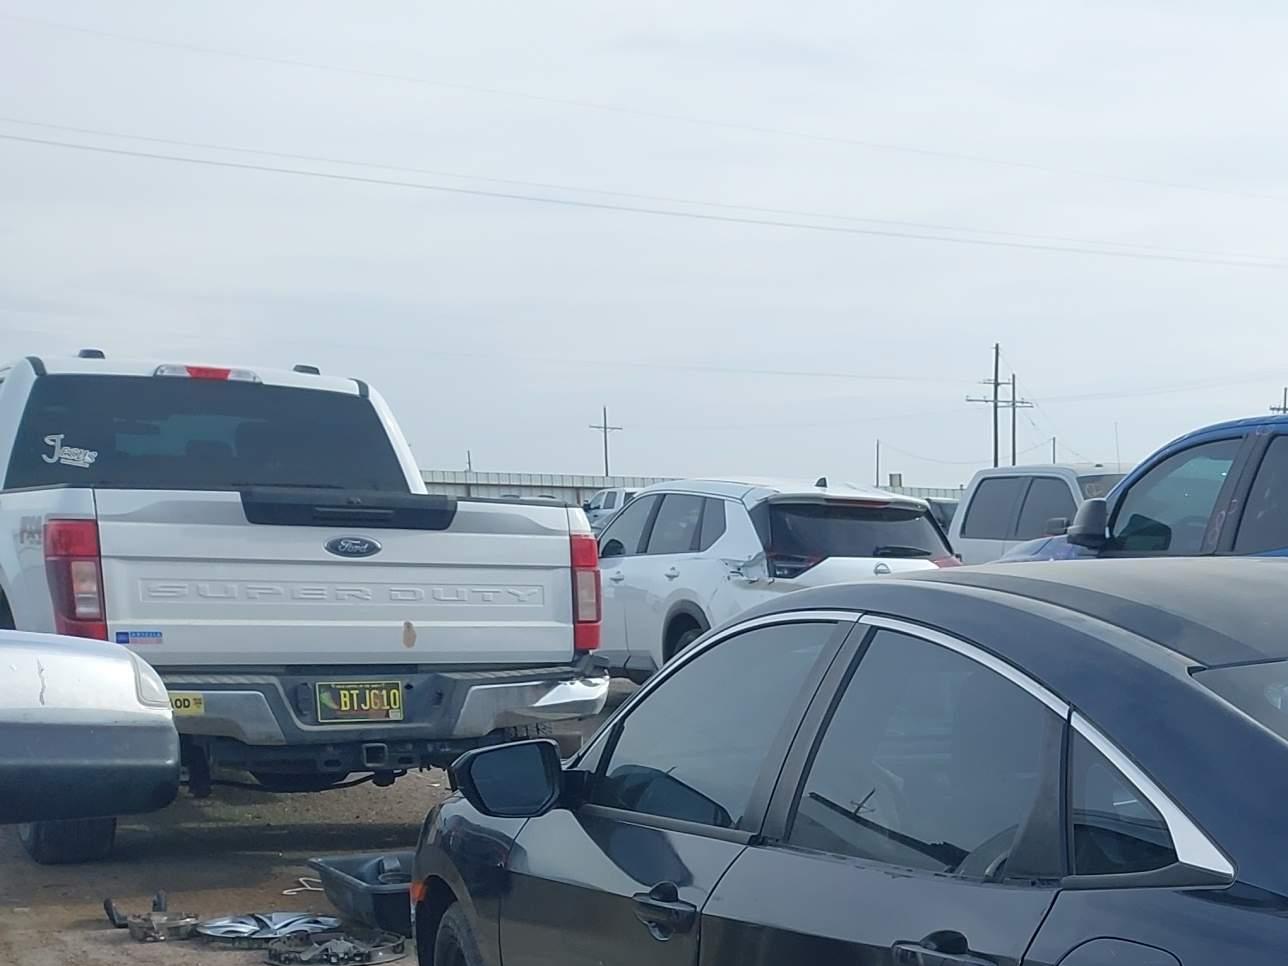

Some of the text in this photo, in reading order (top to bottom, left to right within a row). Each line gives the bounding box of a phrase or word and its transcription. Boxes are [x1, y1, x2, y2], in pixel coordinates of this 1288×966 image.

[338, 539, 369, 552] Ford
[147, 584, 540, 603] SUPER DUTY
